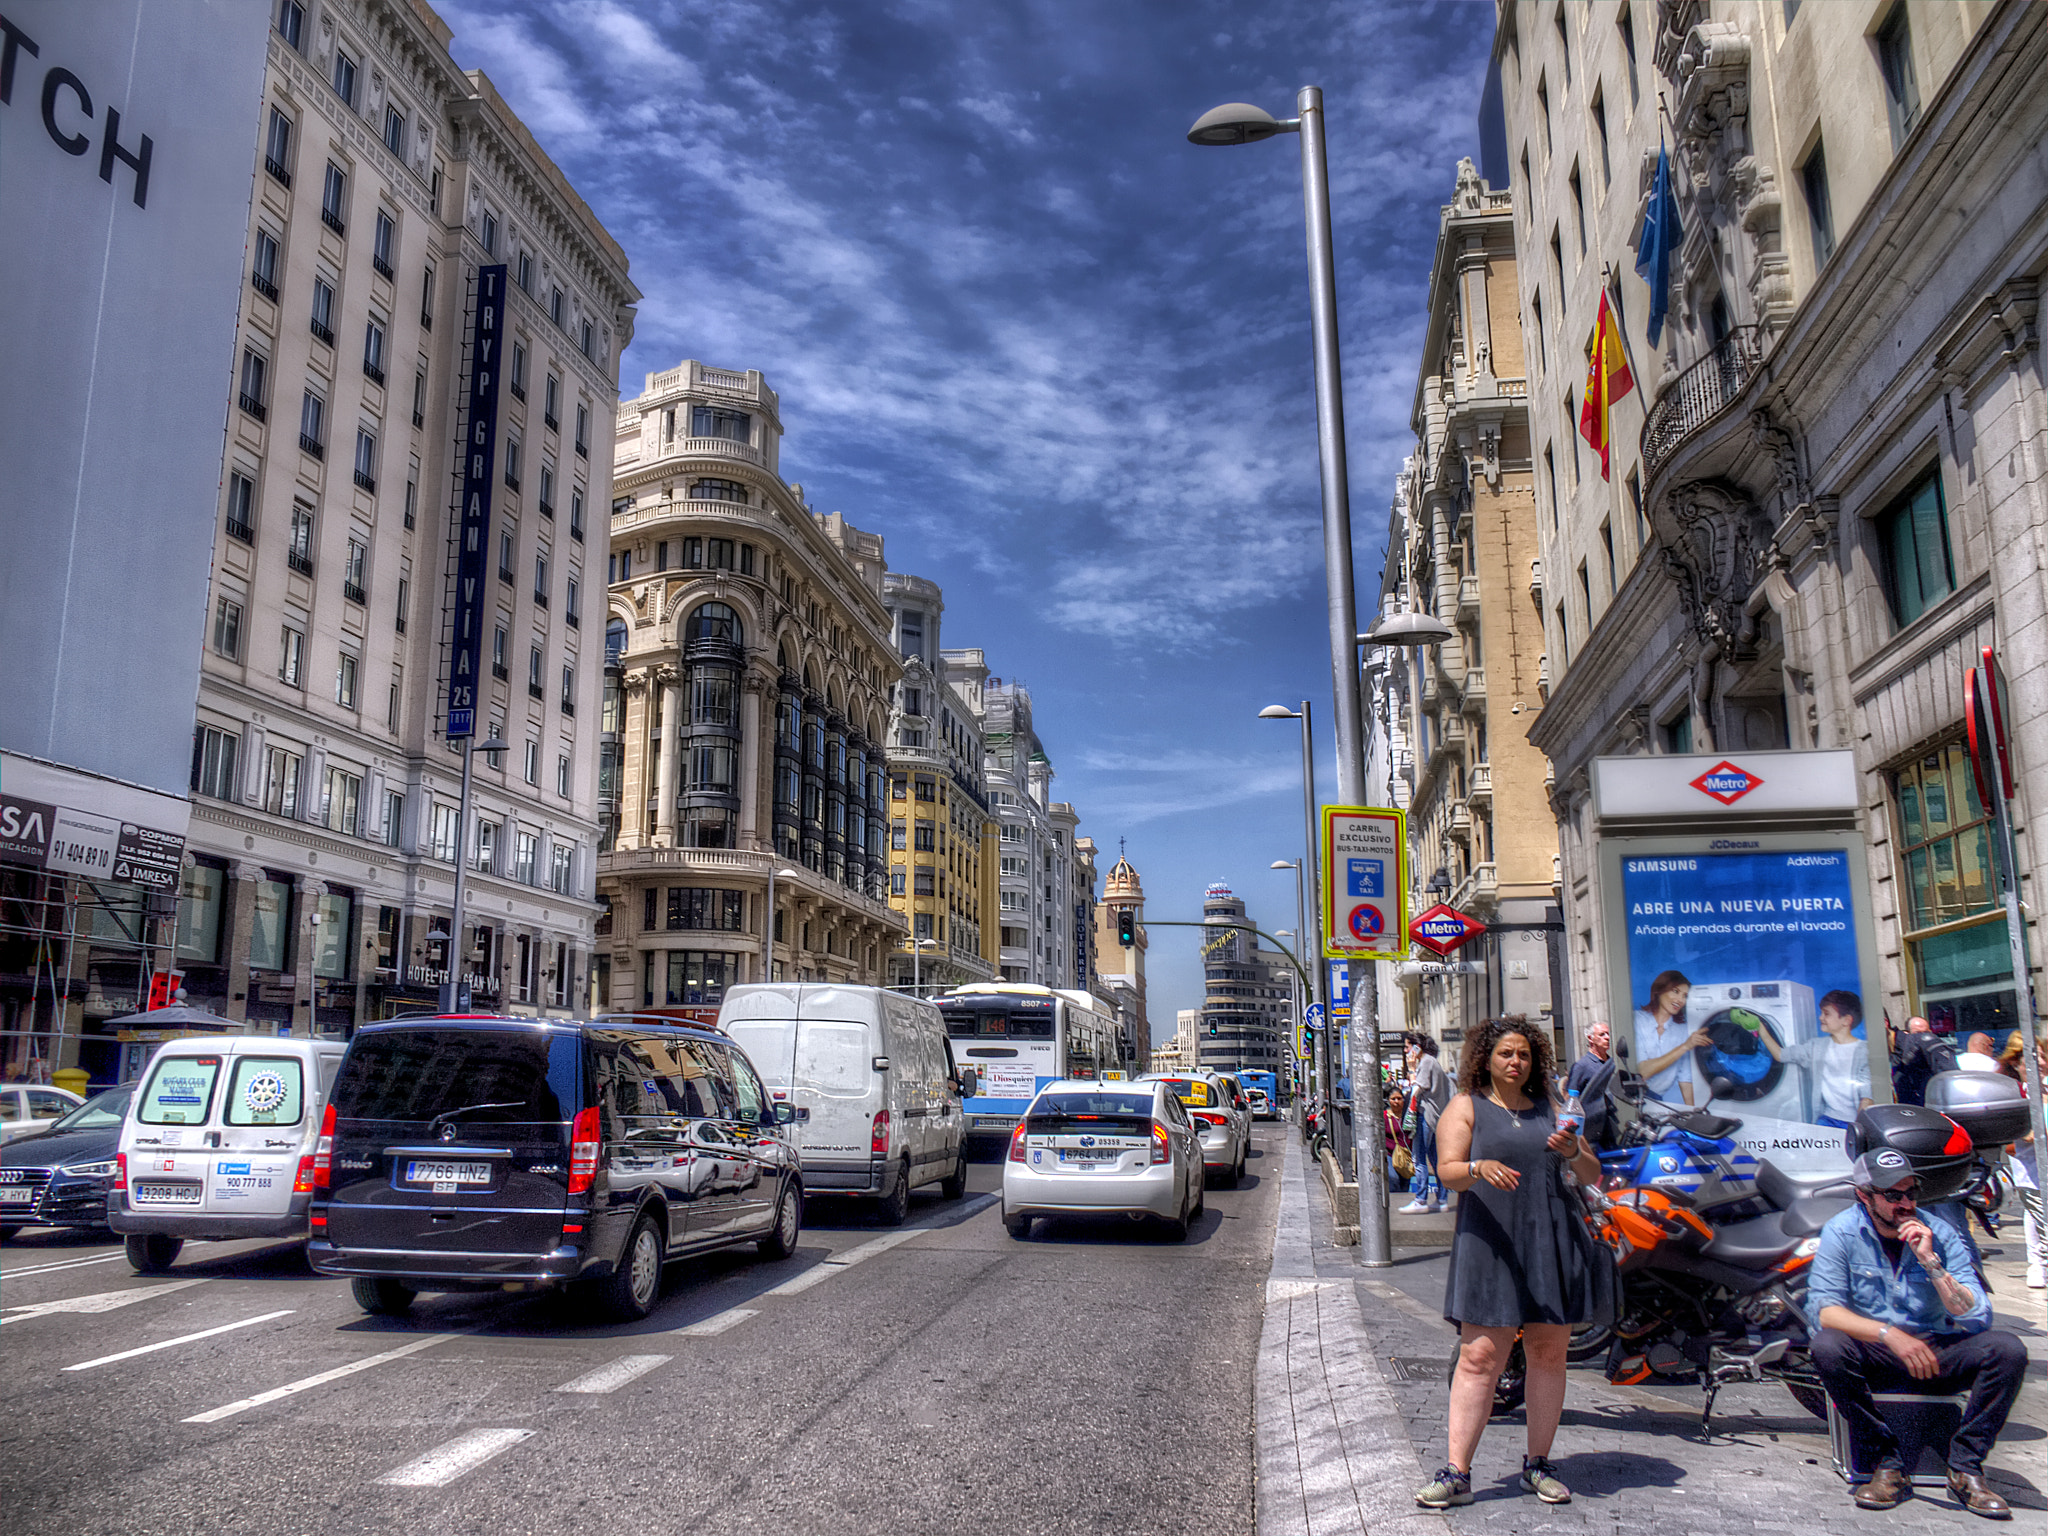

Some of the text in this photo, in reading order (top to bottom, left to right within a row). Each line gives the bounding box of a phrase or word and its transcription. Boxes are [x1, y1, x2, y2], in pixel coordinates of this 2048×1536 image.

[479, 273, 496, 396] TRYP
[467, 420, 486, 552] GRAN
[453, 686, 471, 706] 25
[1707, 777, 1746, 790] Metro
[0, 804, 45, 843] SA
[1349, 824, 1382, 833] CARRIL
[139, 829, 185, 845] COPMOR
[1340, 833, 1392, 844] EXCLUSIVO
[1336, 845, 1394, 854] BUS-TAXI-MOTOS
[1709, 840, 1760, 849] JCDecaux
[54, 839, 109, 868] 91 404 89 10
[1628, 859, 1698, 873] SAMSUNG
[1786, 856, 1840, 867] AddWash
[132, 867, 174, 885] IMRESA
[1632, 898, 1844, 915] ABRE UNA NUEVA PUERTA
[1424, 922, 1462, 935] Metro
[1635, 919, 1846, 937] Añade prendas durante el lavado
[1077, 918, 1085, 956] HOTEL
[408, 964, 436, 984] HOTEL
[1421, 963, 1447, 972] Gran
[1020, 999, 1041, 1008] 8507
[1380, 1032, 1402, 1043] pans
[1107, 1072, 1121, 1080] TAXI
[1047, 1136, 1056, 1147] M
[1772, 1138, 1841, 1150] AddWash
[1066, 1150, 1114, 1159] 6764 JLH
[416, 1164, 487, 1181] 7766 HNZ
[227, 1177, 241, 1187] 900
[243, 1177, 256, 1187] 777
[435, 1182, 454, 1192] SP
[11, 1190, 28, 1199] HYV
[143, 1187, 199, 1200] 3208 HCJ
